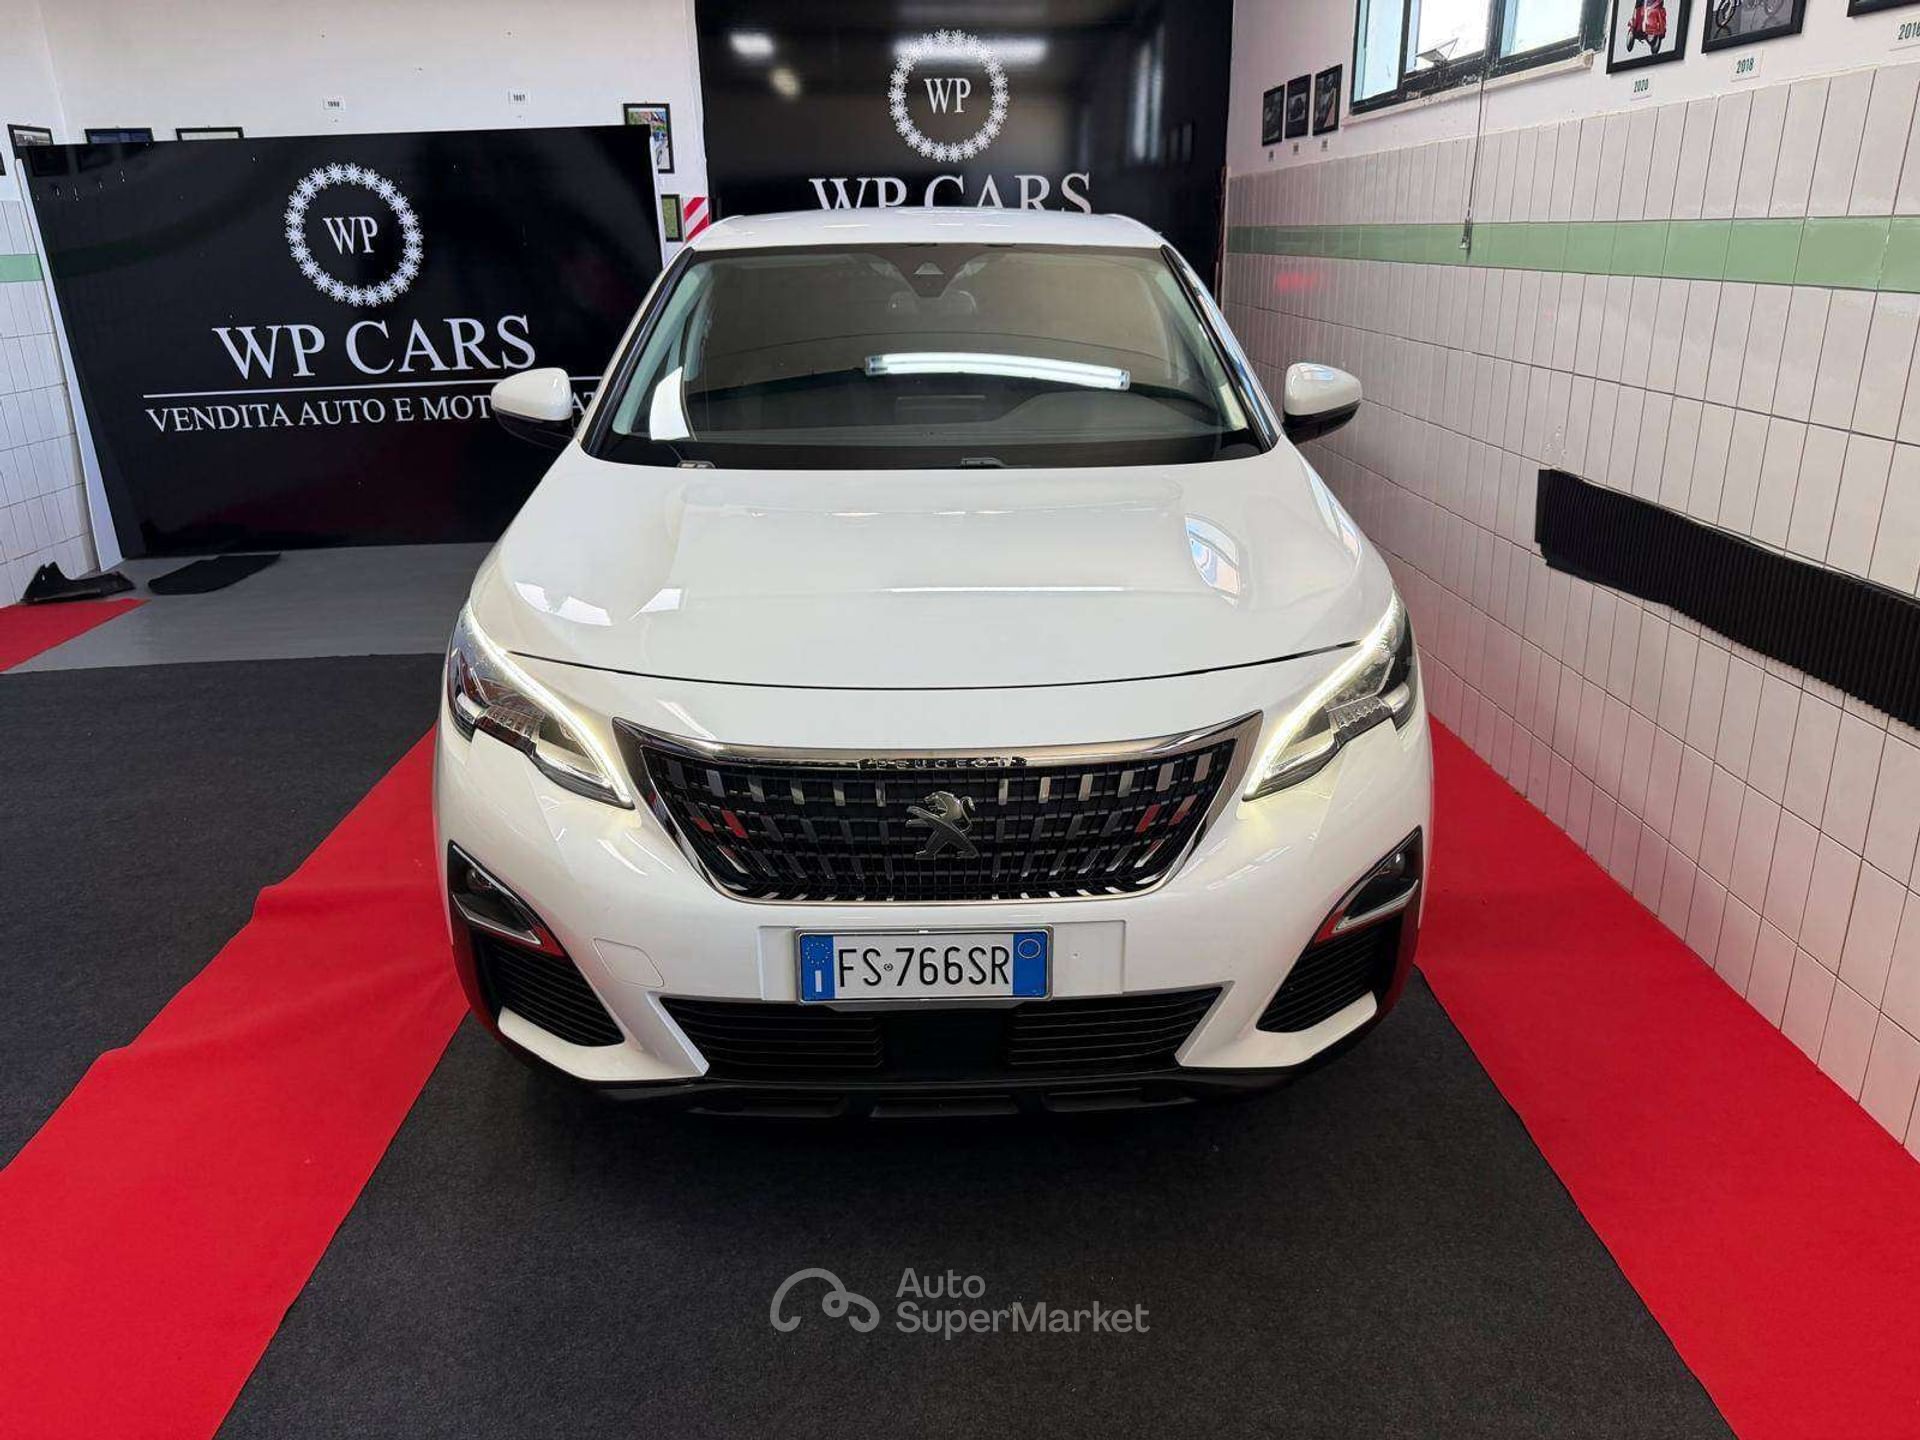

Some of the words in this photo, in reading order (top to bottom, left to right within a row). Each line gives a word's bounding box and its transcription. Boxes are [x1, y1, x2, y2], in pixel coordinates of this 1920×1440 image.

[1736, 57, 1754, 74] 2018
[923, 78, 972, 114] WP
[808, 177, 907, 210] WP
[923, 172, 1092, 214] CARS
[322, 216, 379, 255] WP
[212, 324, 326, 381] WP
[345, 314, 536, 375] CARS
[145, 403, 294, 433] VENDITA
[298, 398, 386, 426] AUTO
[392, 397, 416, 423] E
[420, 394, 492, 421] MOT
